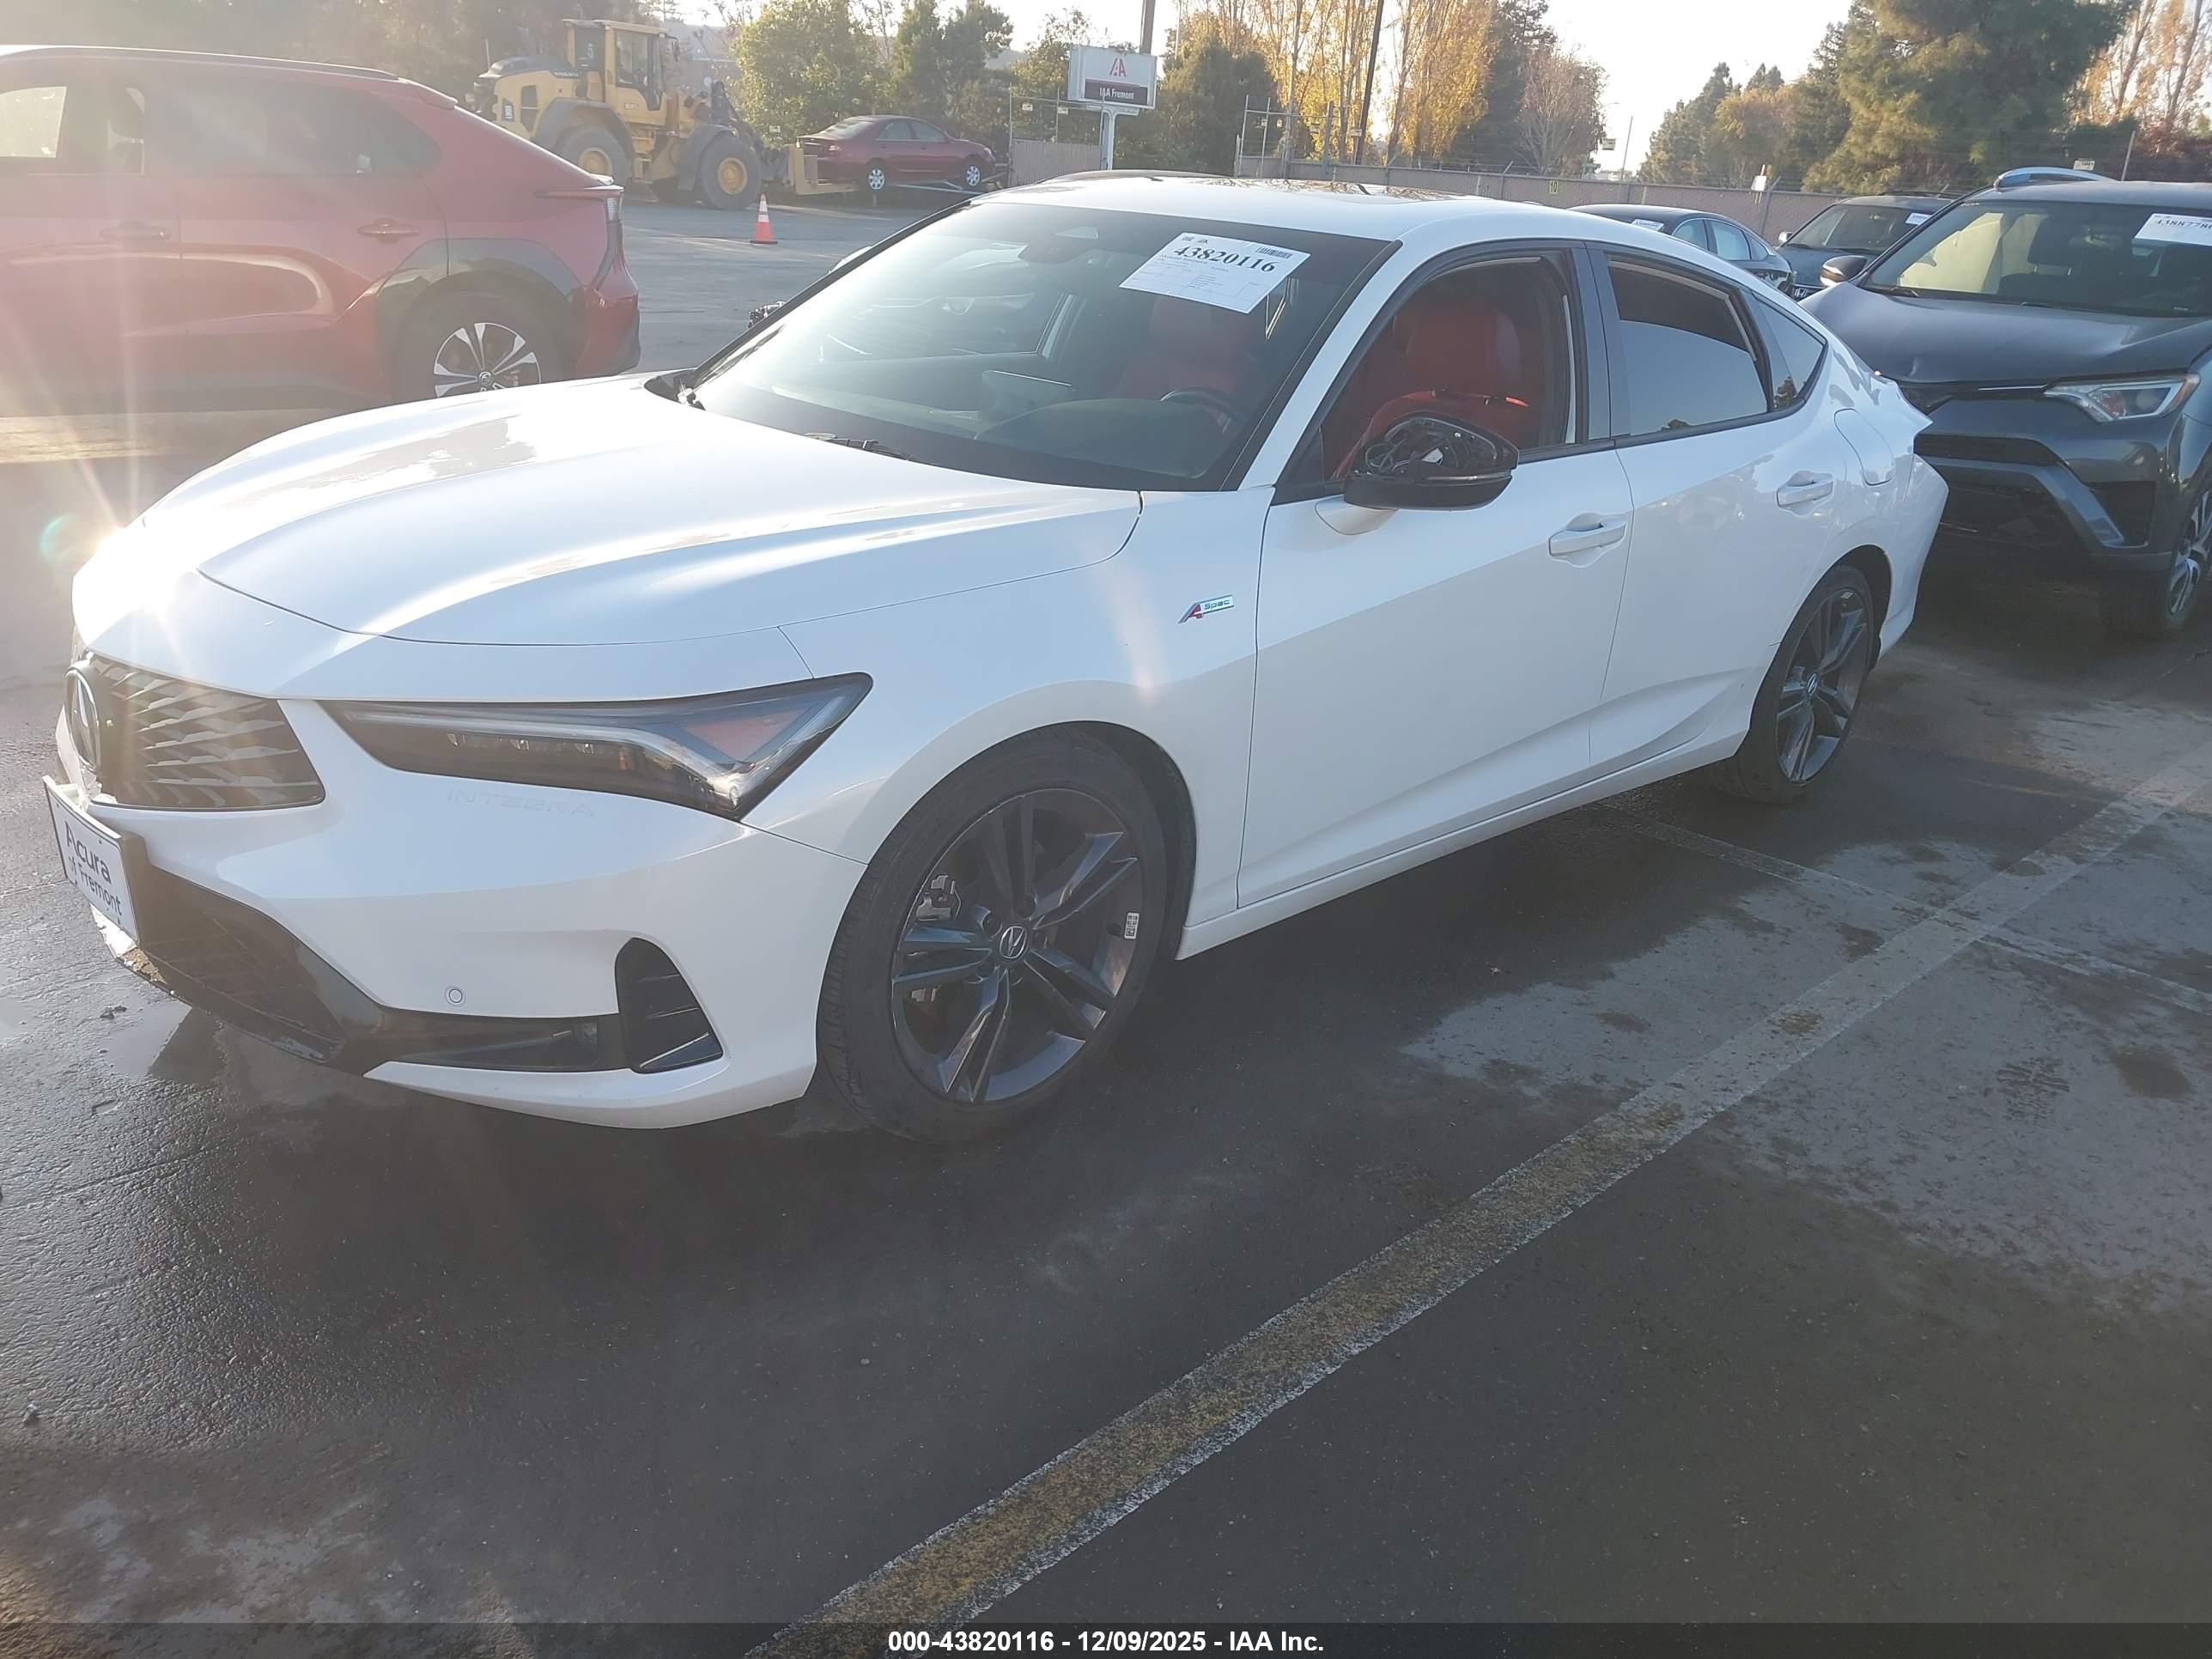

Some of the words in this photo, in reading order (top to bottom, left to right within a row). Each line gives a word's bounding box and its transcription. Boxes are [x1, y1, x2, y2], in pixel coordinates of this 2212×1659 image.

[1112, 88, 1134, 100] Fremont
[1550, 180, 1558, 193] 10
[1174, 246, 1282, 272] 43820116
[447, 789, 595, 817] INTEGRA
[64, 820, 112, 884] Acura
[68, 856, 77, 875] of
[78, 863, 123, 916] Fremont
